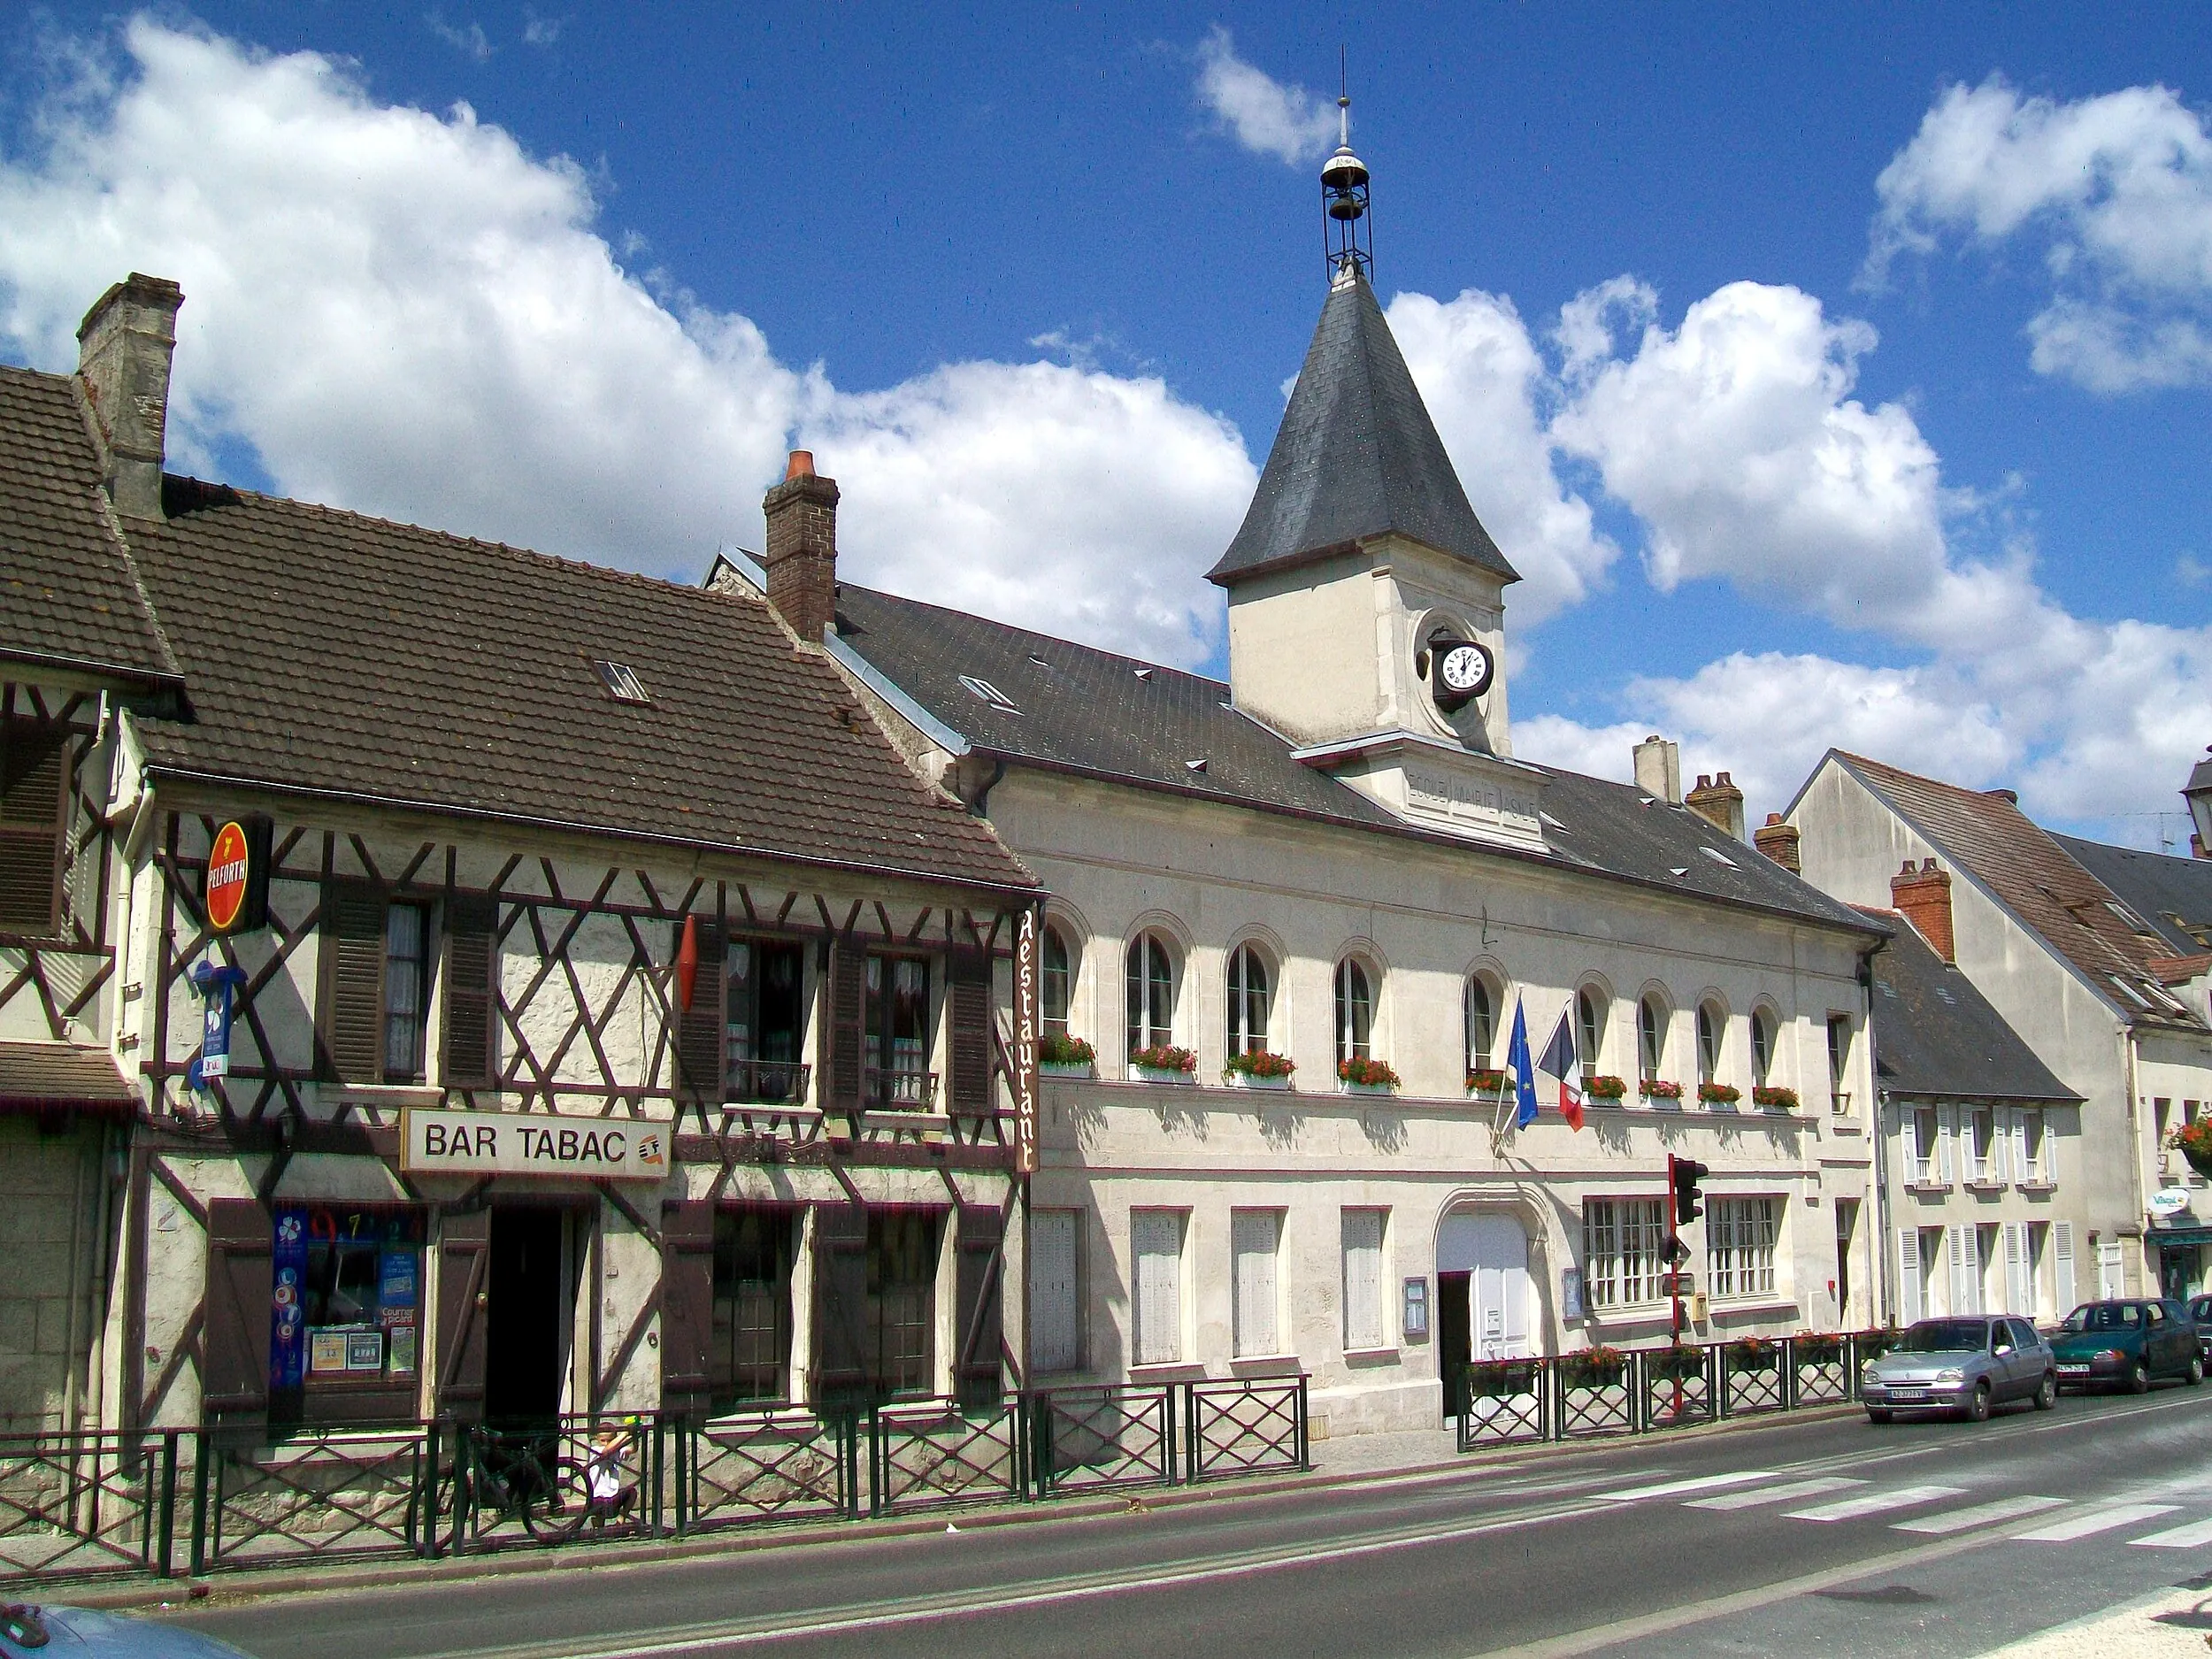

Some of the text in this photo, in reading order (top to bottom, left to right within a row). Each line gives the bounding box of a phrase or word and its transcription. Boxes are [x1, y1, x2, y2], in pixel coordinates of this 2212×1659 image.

[208, 859, 246, 889] PELFORTH
[425, 1123, 626, 1163] BAR TABAC
